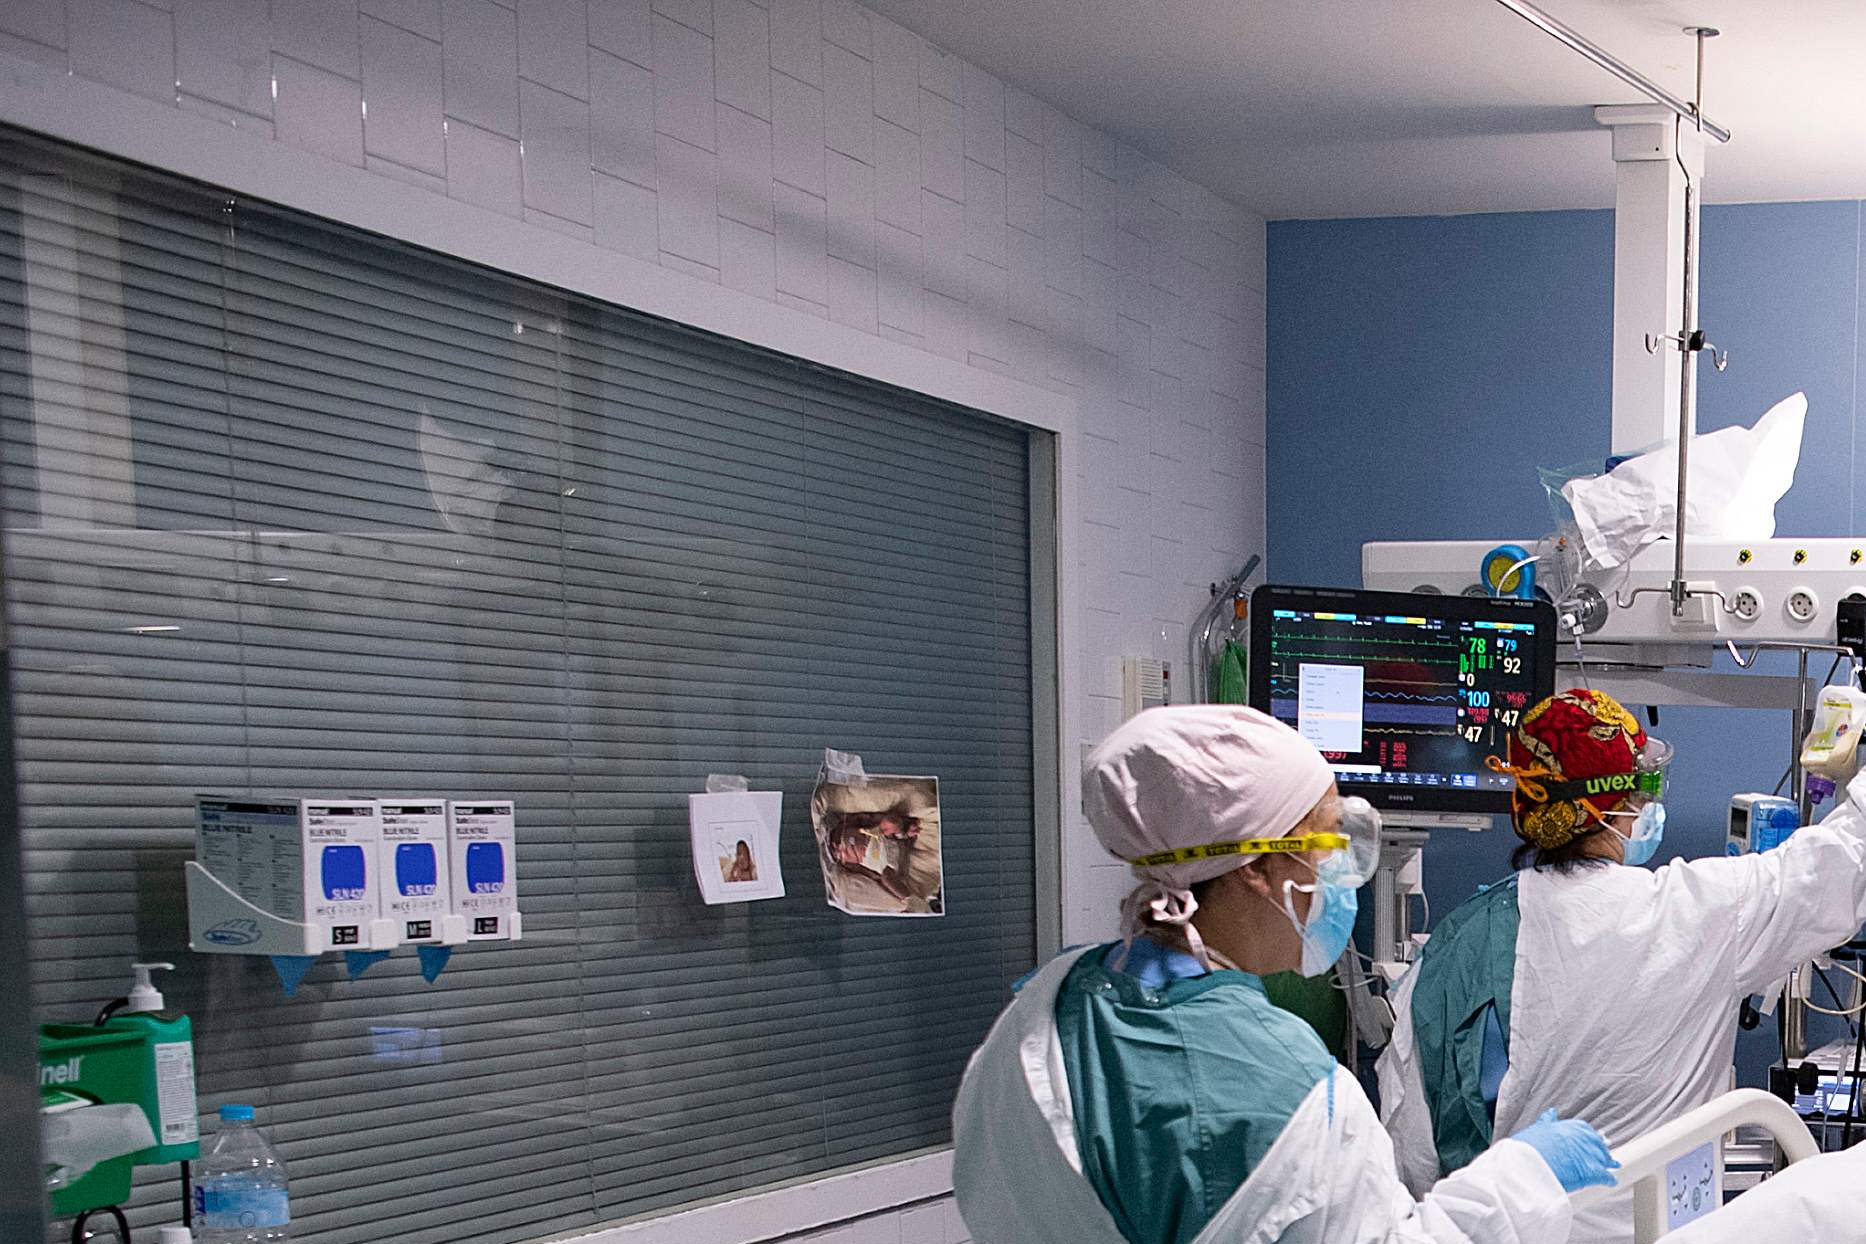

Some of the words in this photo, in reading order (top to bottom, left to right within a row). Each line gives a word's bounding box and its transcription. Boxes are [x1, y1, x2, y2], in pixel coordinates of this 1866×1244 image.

[1469, 637, 1487, 654] 78
[1504, 639, 1518, 652] 79
[1503, 657, 1521, 674] 92
[1466, 673, 1475, 687] 0
[1467, 690, 1490, 707] 100
[1501, 710, 1519, 727] 47
[1464, 726, 1483, 743] 47
[1586, 775, 1636, 794] uvex
[41, 1056, 80, 1085] nell
